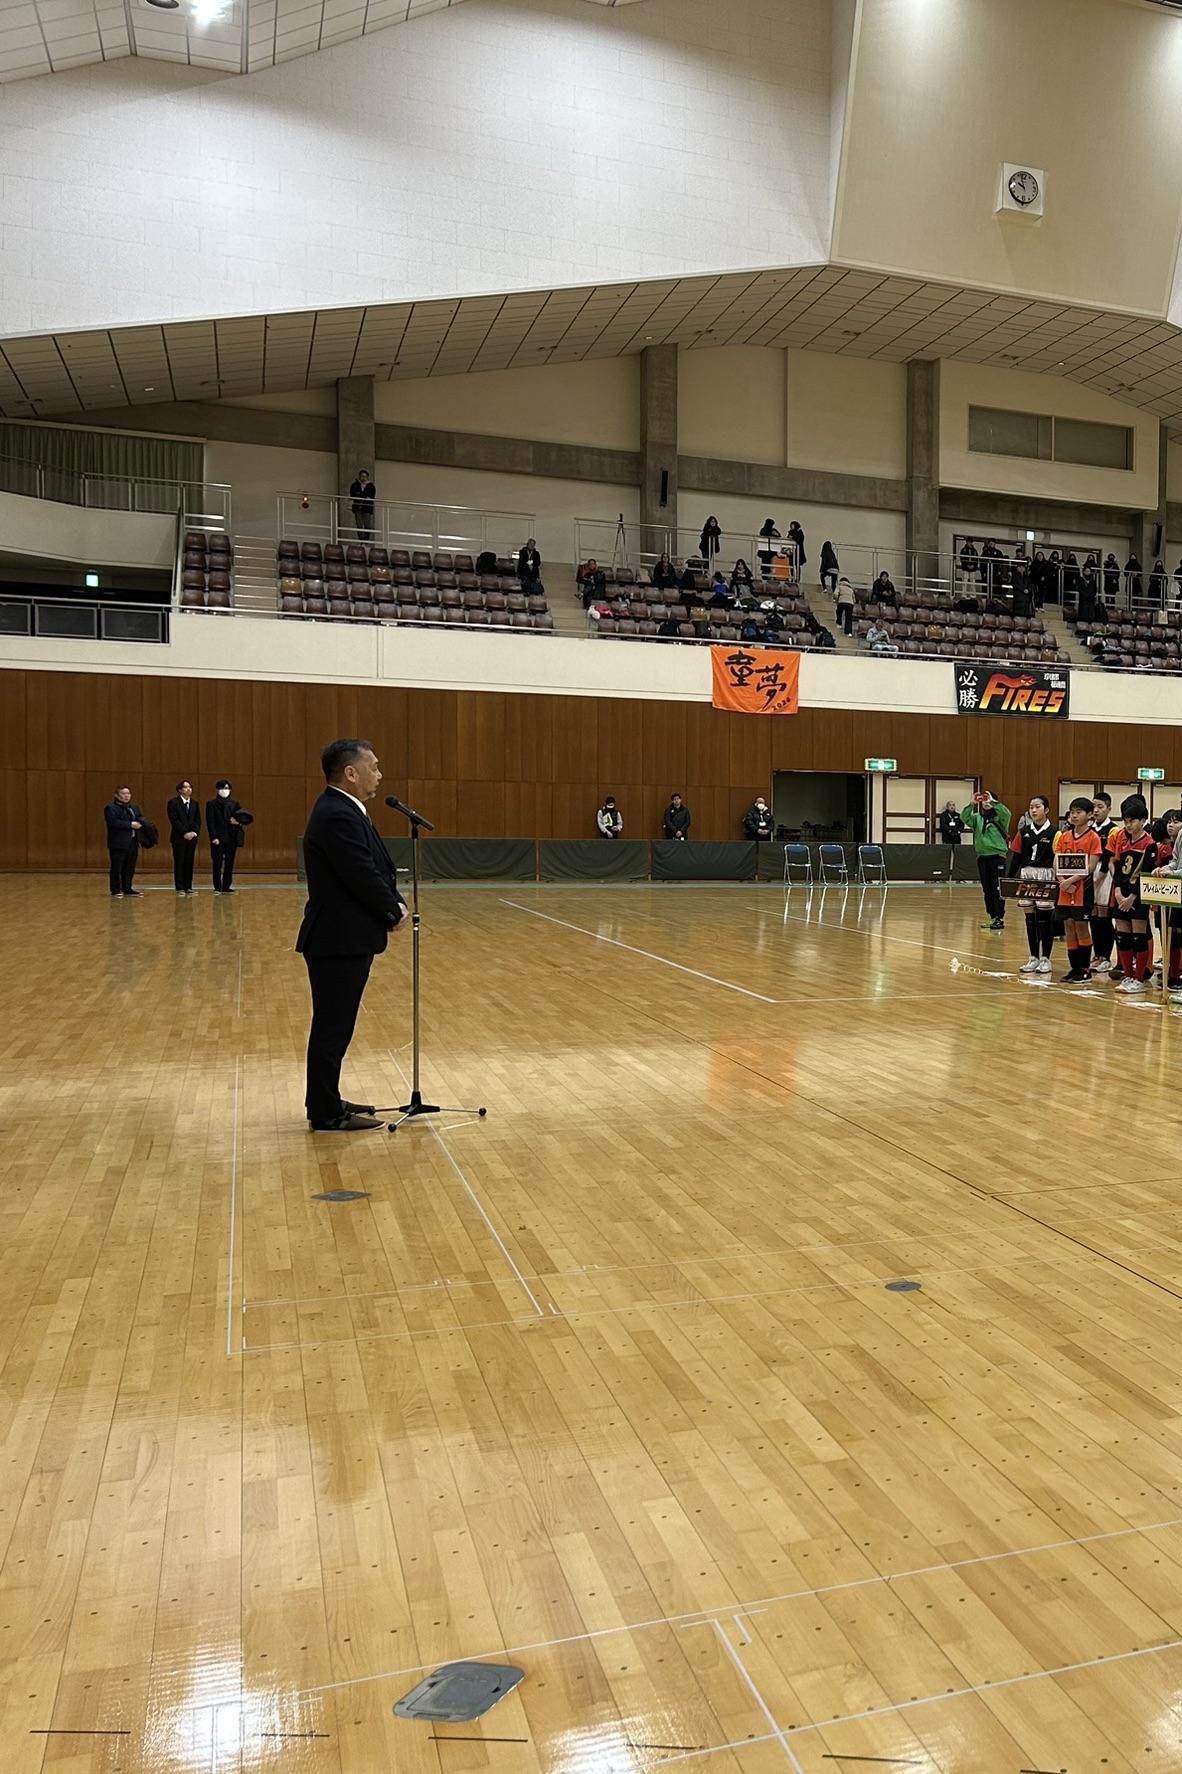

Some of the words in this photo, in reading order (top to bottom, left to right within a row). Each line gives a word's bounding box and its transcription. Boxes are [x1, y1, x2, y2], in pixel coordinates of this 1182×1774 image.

[958, 669, 979, 709] 必勝
[979, 673, 1066, 713] FIRES
[1031, 843, 1038, 861] 1
[1121, 854, 1134, 875] 3
[1015, 882, 1051, 898] FIRES
